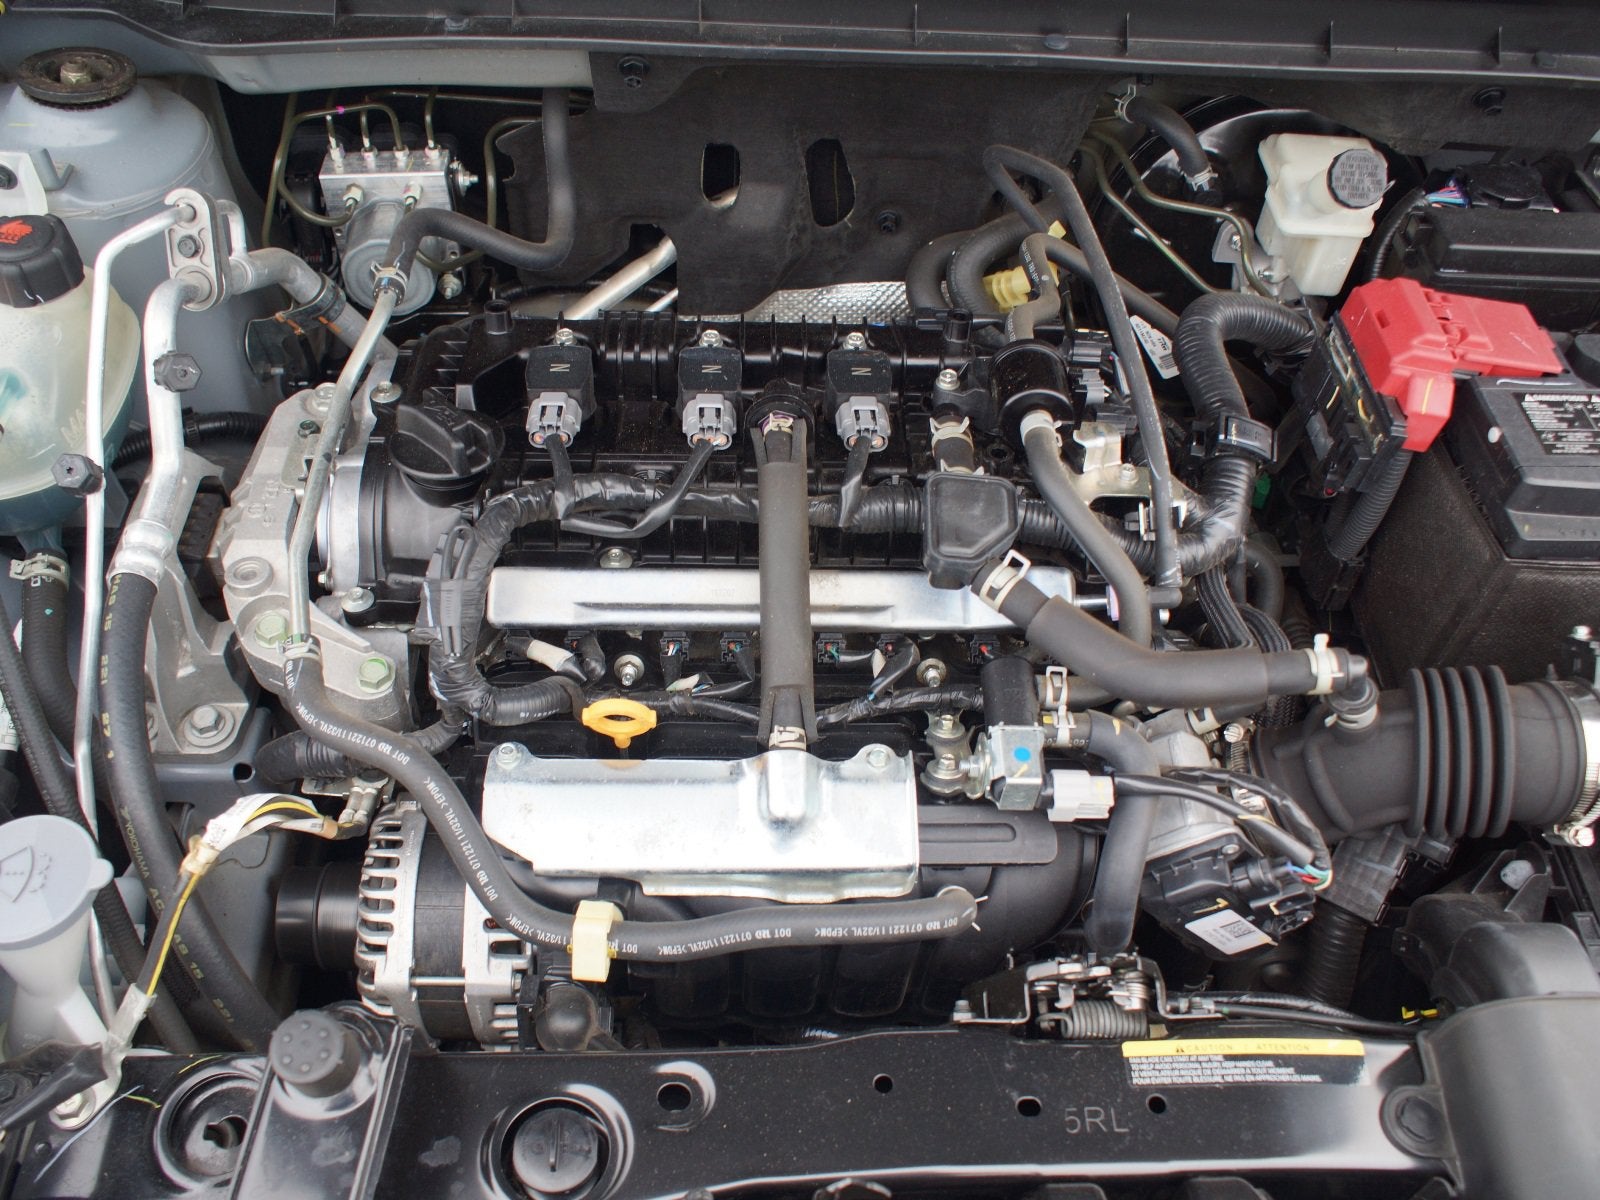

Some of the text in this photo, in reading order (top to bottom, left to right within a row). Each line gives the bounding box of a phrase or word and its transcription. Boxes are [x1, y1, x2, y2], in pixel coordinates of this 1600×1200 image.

[392, 753, 410, 766] DOT
[125, 822, 150, 880] YOKOHAMA
[483, 885, 499, 902] DOT
[943, 917, 958, 929] DOT
[774, 927, 792, 938] DOT
[622, 943, 638, 954] DOT
[1065, 1106, 1130, 1134] 5RL
